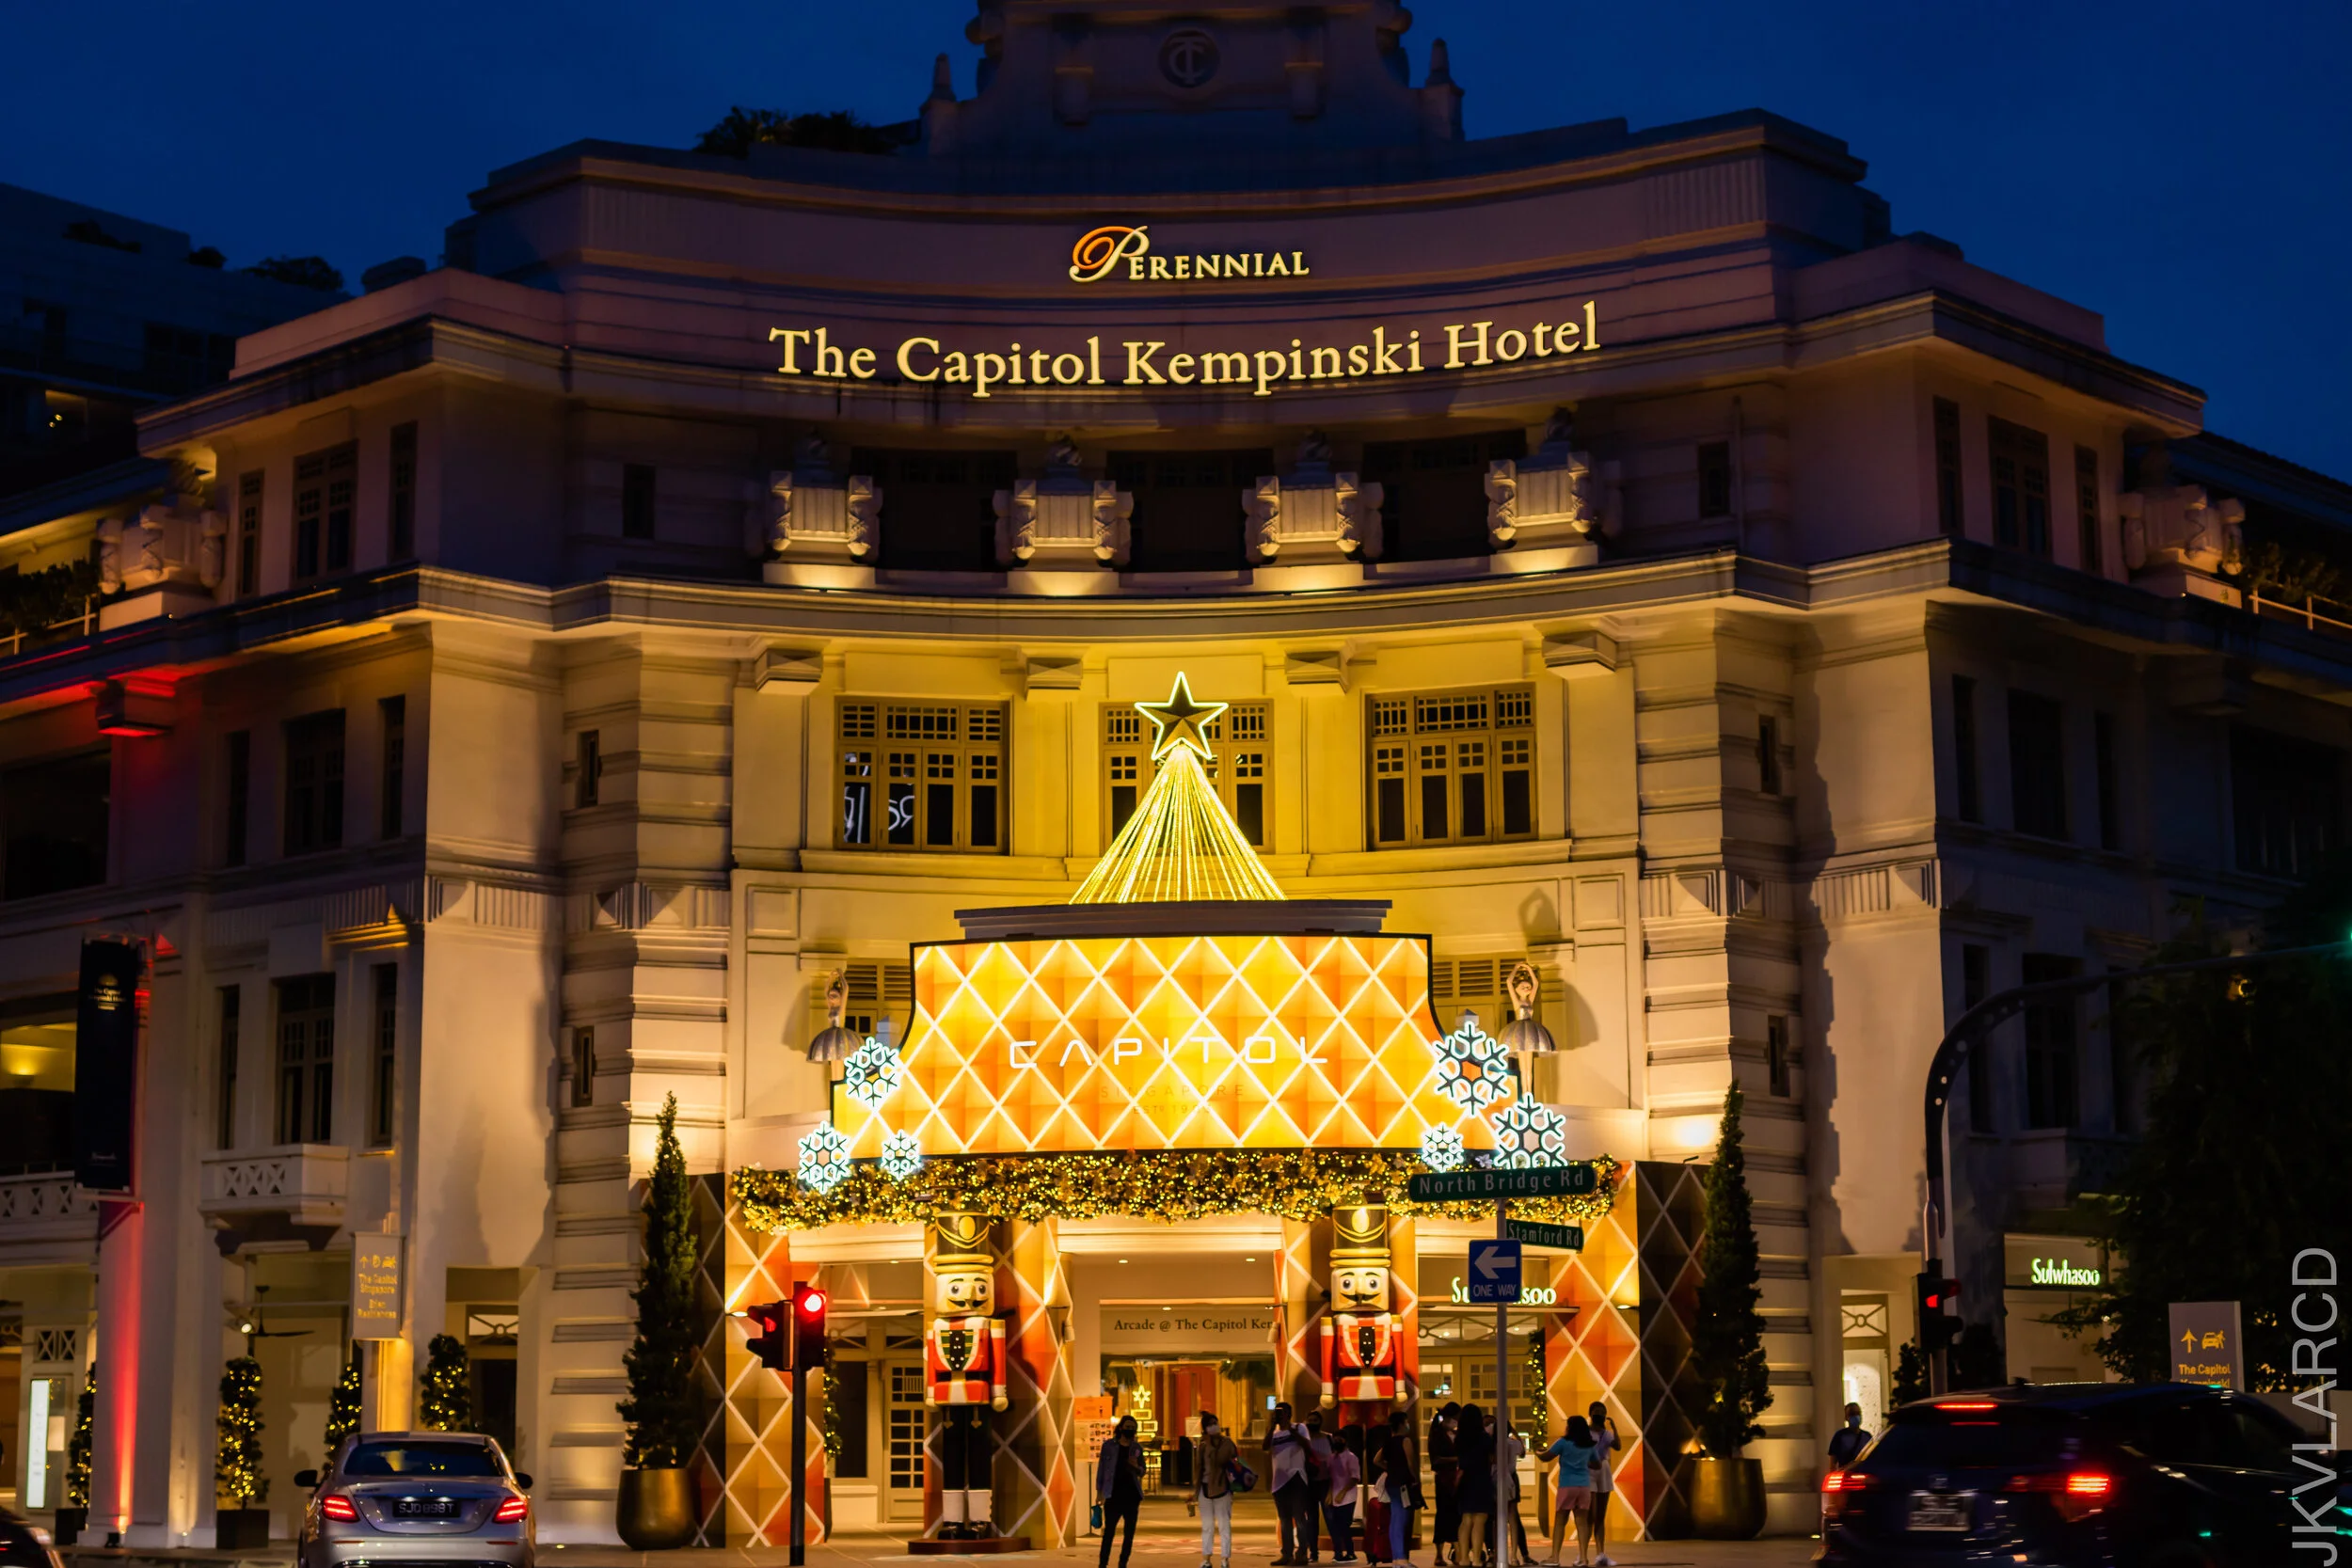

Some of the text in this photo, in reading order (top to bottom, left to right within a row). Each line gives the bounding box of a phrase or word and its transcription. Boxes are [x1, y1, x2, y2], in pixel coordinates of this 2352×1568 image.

[769, 300, 1601, 398] The Capitol Kempinski Hotel
[1009, 1036, 1328, 1069] CAPITOL
[1101, 1084, 1245, 1098] SINGAPORE
[1419, 1169, 1583, 1195] North Bridge Rd
[1508, 1223, 1580, 1247] Stamford Rd
[2031, 1258, 2101, 1286] Sulwhasoo
[1451, 1276, 1557, 1305] Susoo
[1472, 1284, 1517, 1297] ONE WAY
[1114, 1319, 1155, 1331] Arcade
[1159, 1321, 1171, 1332] @
[1175, 1319, 1199, 1330] The
[1202, 1319, 1247, 1332] Capitol
[2178, 1363, 2231, 1377] The Capitol
